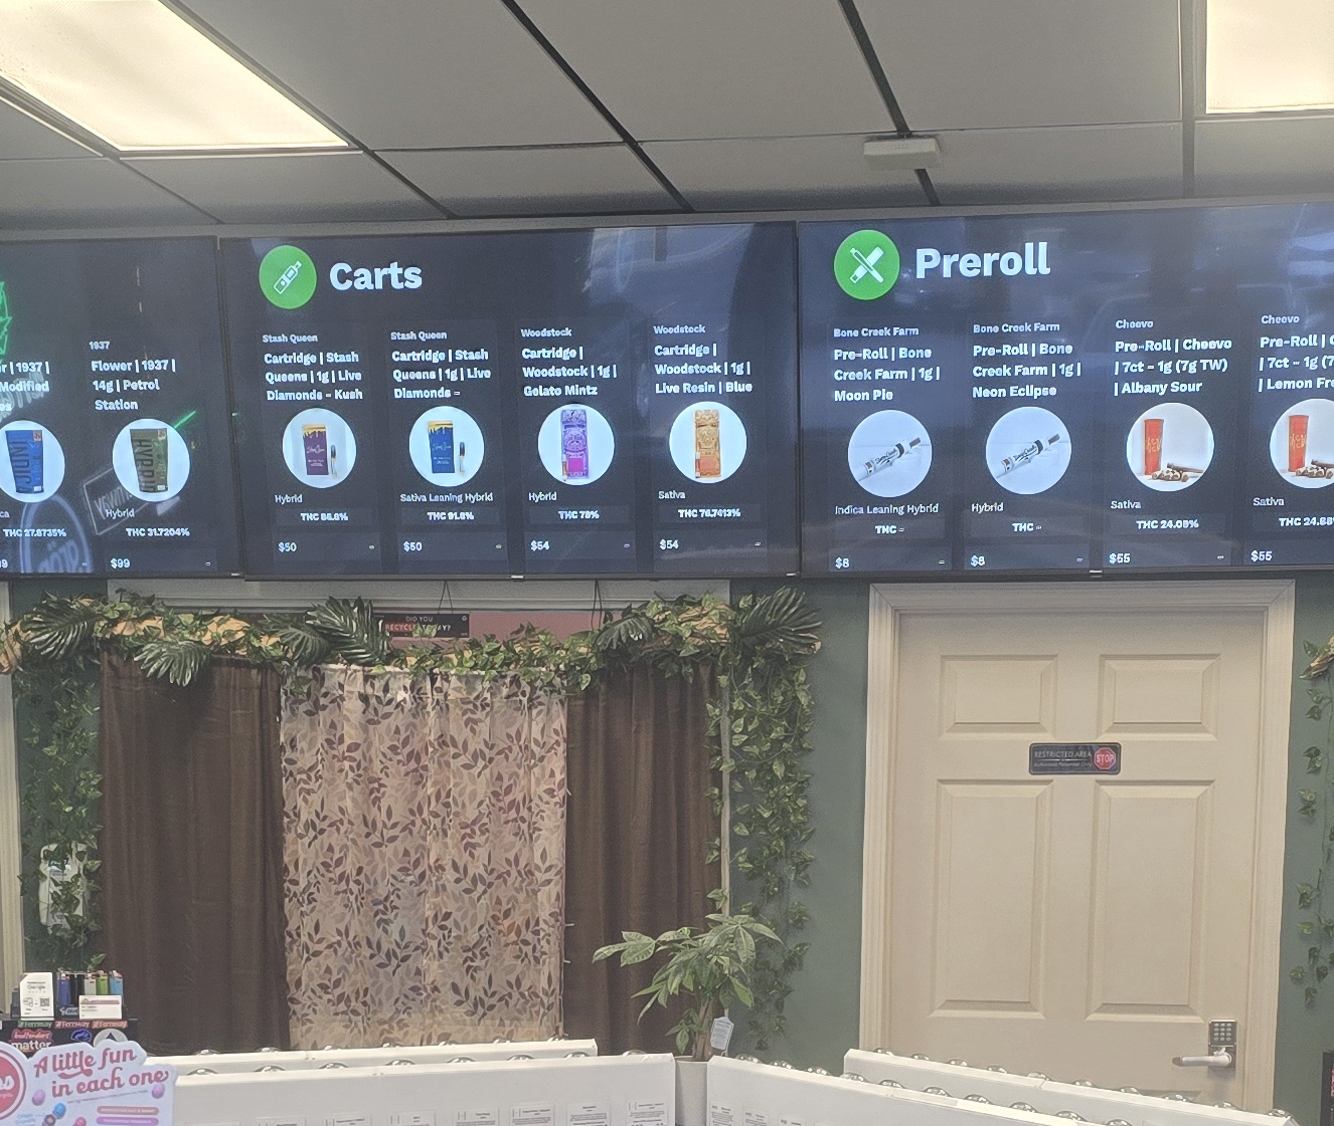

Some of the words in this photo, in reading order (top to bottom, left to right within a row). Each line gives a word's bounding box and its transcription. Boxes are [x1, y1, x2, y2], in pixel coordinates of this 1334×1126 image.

[915, 242, 1050, 279] Preroll
[329, 262, 422, 291] Carts
[89, 342, 110, 350] 1937
[1115, 341, 1171, 352] Pre-Roll
[1261, 336, 1318, 347] Pre-Roll
[455, 349, 488, 360] Stash
[834, 348, 888, 360] Pre-Roll
[973, 344, 1028, 357] Pre-Roll
[326, 352, 359, 363] Stash
[16, 362, 42, 372] 1937
[91, 361, 132, 371] Flower
[142, 360, 168, 371] 1937
[655, 363, 721, 375] Woodstock
[1014, 365, 1047, 376] Farm
[522, 366, 588, 377] Woodstock
[875, 369, 908, 379] Farm
[124, 379, 159, 390] Petrol
[725, 382, 752, 392] Blue
[1122, 383, 1167, 395] Albany
[1170, 382, 1202, 392] Sour
[1267, 378, 1313, 389] Lemon
[524, 386, 561, 396] Gelato
[564, 385, 598, 395] Mintz
[973, 387, 1006, 397] Neon
[1010, 385, 1057, 399] Eclipse
[95, 400, 138, 411] Station
[1096, 754, 1114, 763] STOP
[34, 1056, 48, 1077] A
[52, 1050, 96, 1072] little
[98, 1048, 137, 1070] fun
[52, 1081, 73, 1097] in
[77, 1067, 124, 1094] each
[129, 1070, 169, 1085] one
